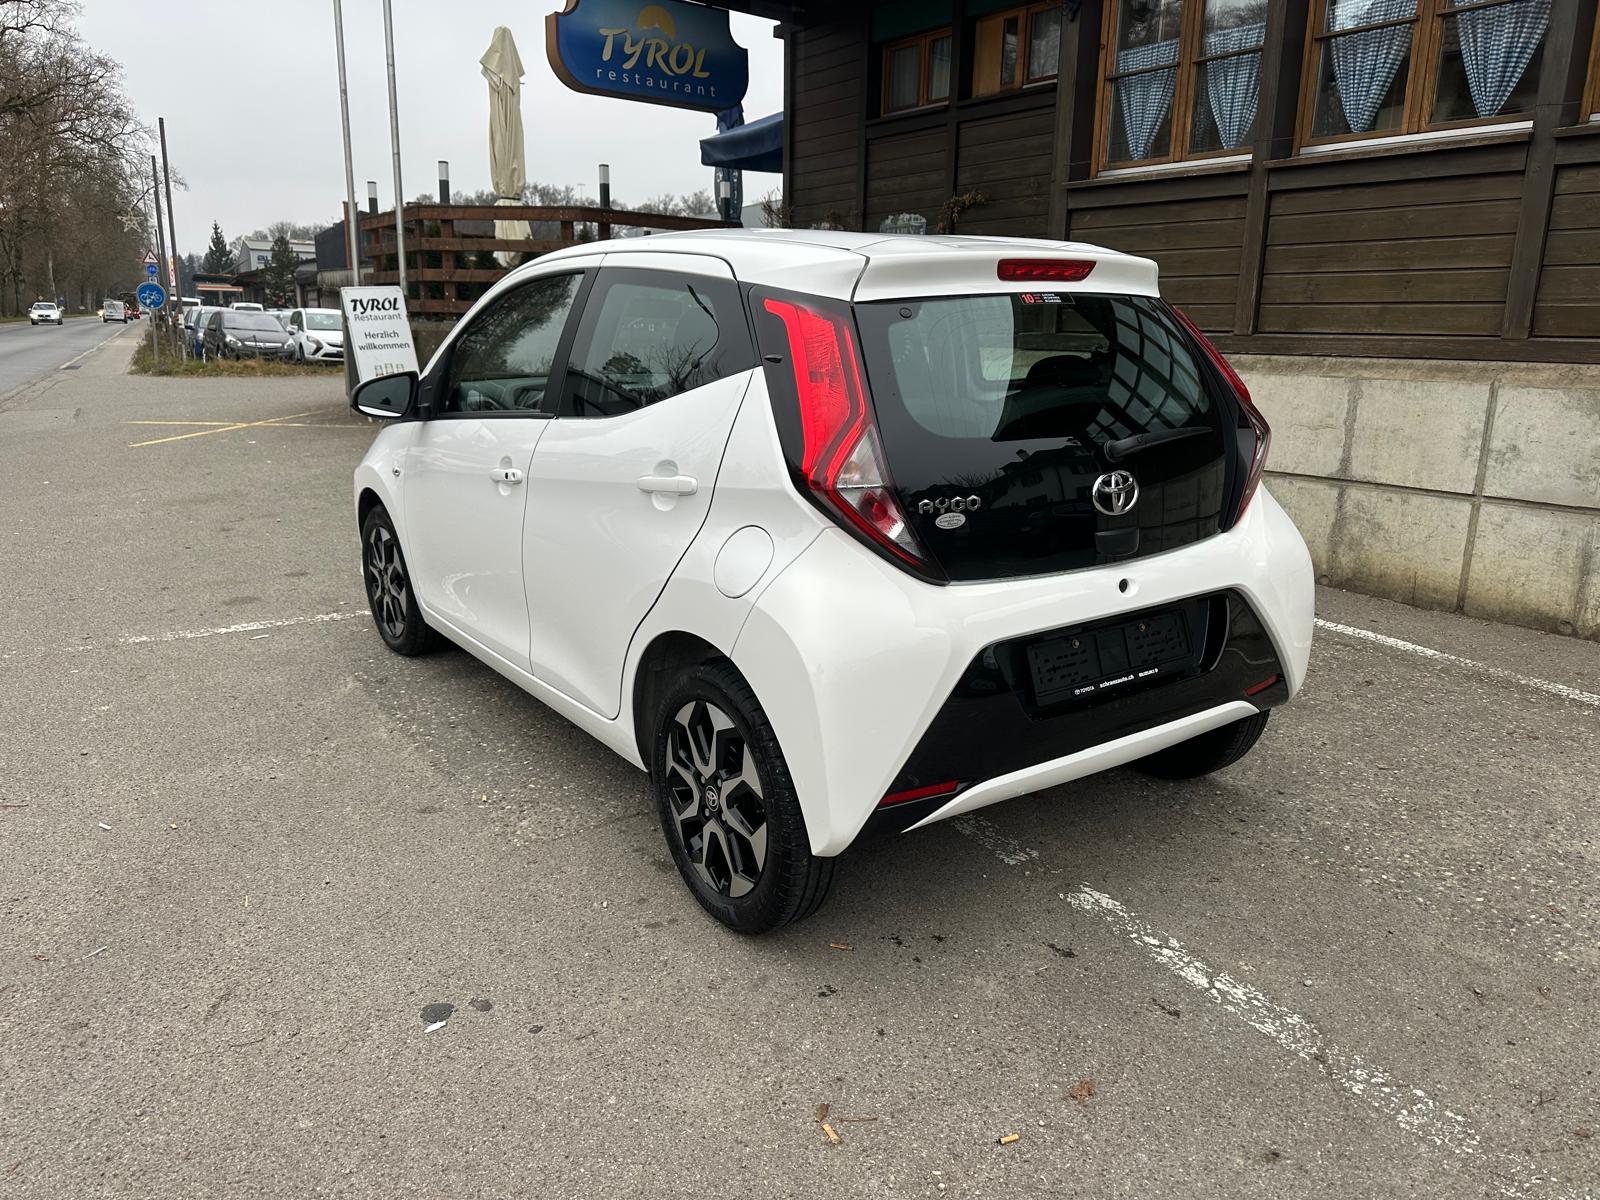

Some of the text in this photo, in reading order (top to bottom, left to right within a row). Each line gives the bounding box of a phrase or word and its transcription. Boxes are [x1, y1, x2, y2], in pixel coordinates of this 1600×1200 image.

[599, 28, 712, 79] TYROL
[596, 68, 716, 97] restaurant
[350, 297, 400, 315] TYROL
[354, 313, 402, 322] Restaurant
[364, 330, 400, 340] Herzlich
[358, 342, 410, 352] willkommen
[918, 494, 982, 515] AYGO
